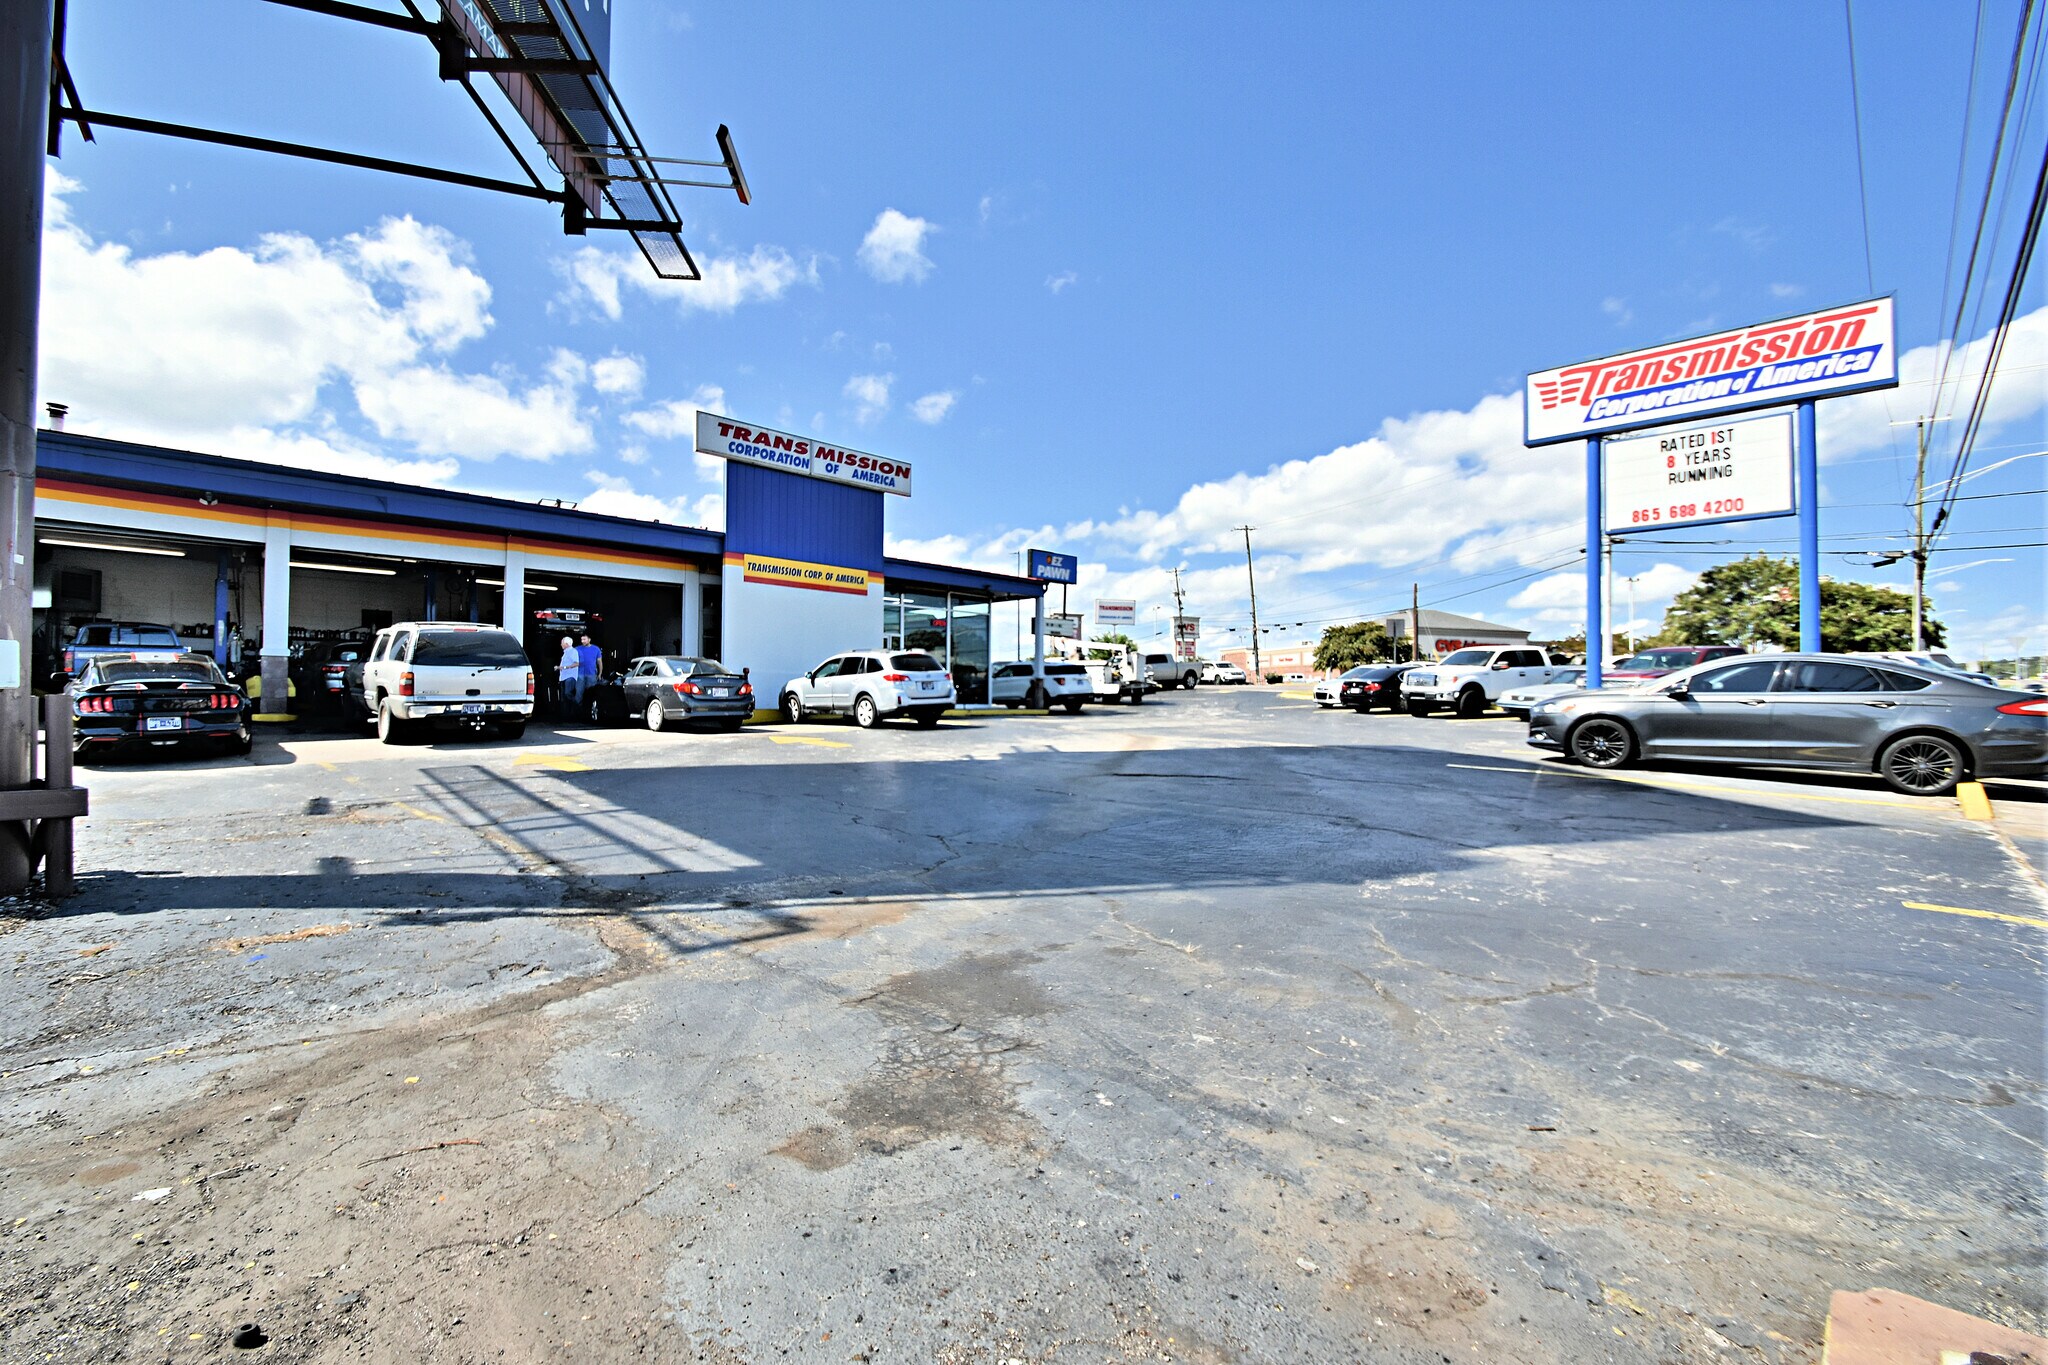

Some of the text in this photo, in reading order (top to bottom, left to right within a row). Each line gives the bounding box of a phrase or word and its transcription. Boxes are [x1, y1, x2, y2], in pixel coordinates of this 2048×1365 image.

[1558, 305, 1878, 407] Transmission
[1588, 349, 1876, 421] Corporation of America
[717, 422, 911, 479] TRANS MISSION
[1660, 428, 1734, 452] RATED 1ST
[728, 441, 896, 488] CORPORATION OF AMERICA
[1667, 447, 1731, 469] 8 YEARS
[1668, 464, 1733, 485] RUNNING
[1632, 497, 1744, 523] 865 688 4200
[747, 561, 865, 585] TRANSMISSION CORP. OF AMERICA
[1036, 564, 1071, 581] PAWN
[1051, 556, 1063, 567] EZ
